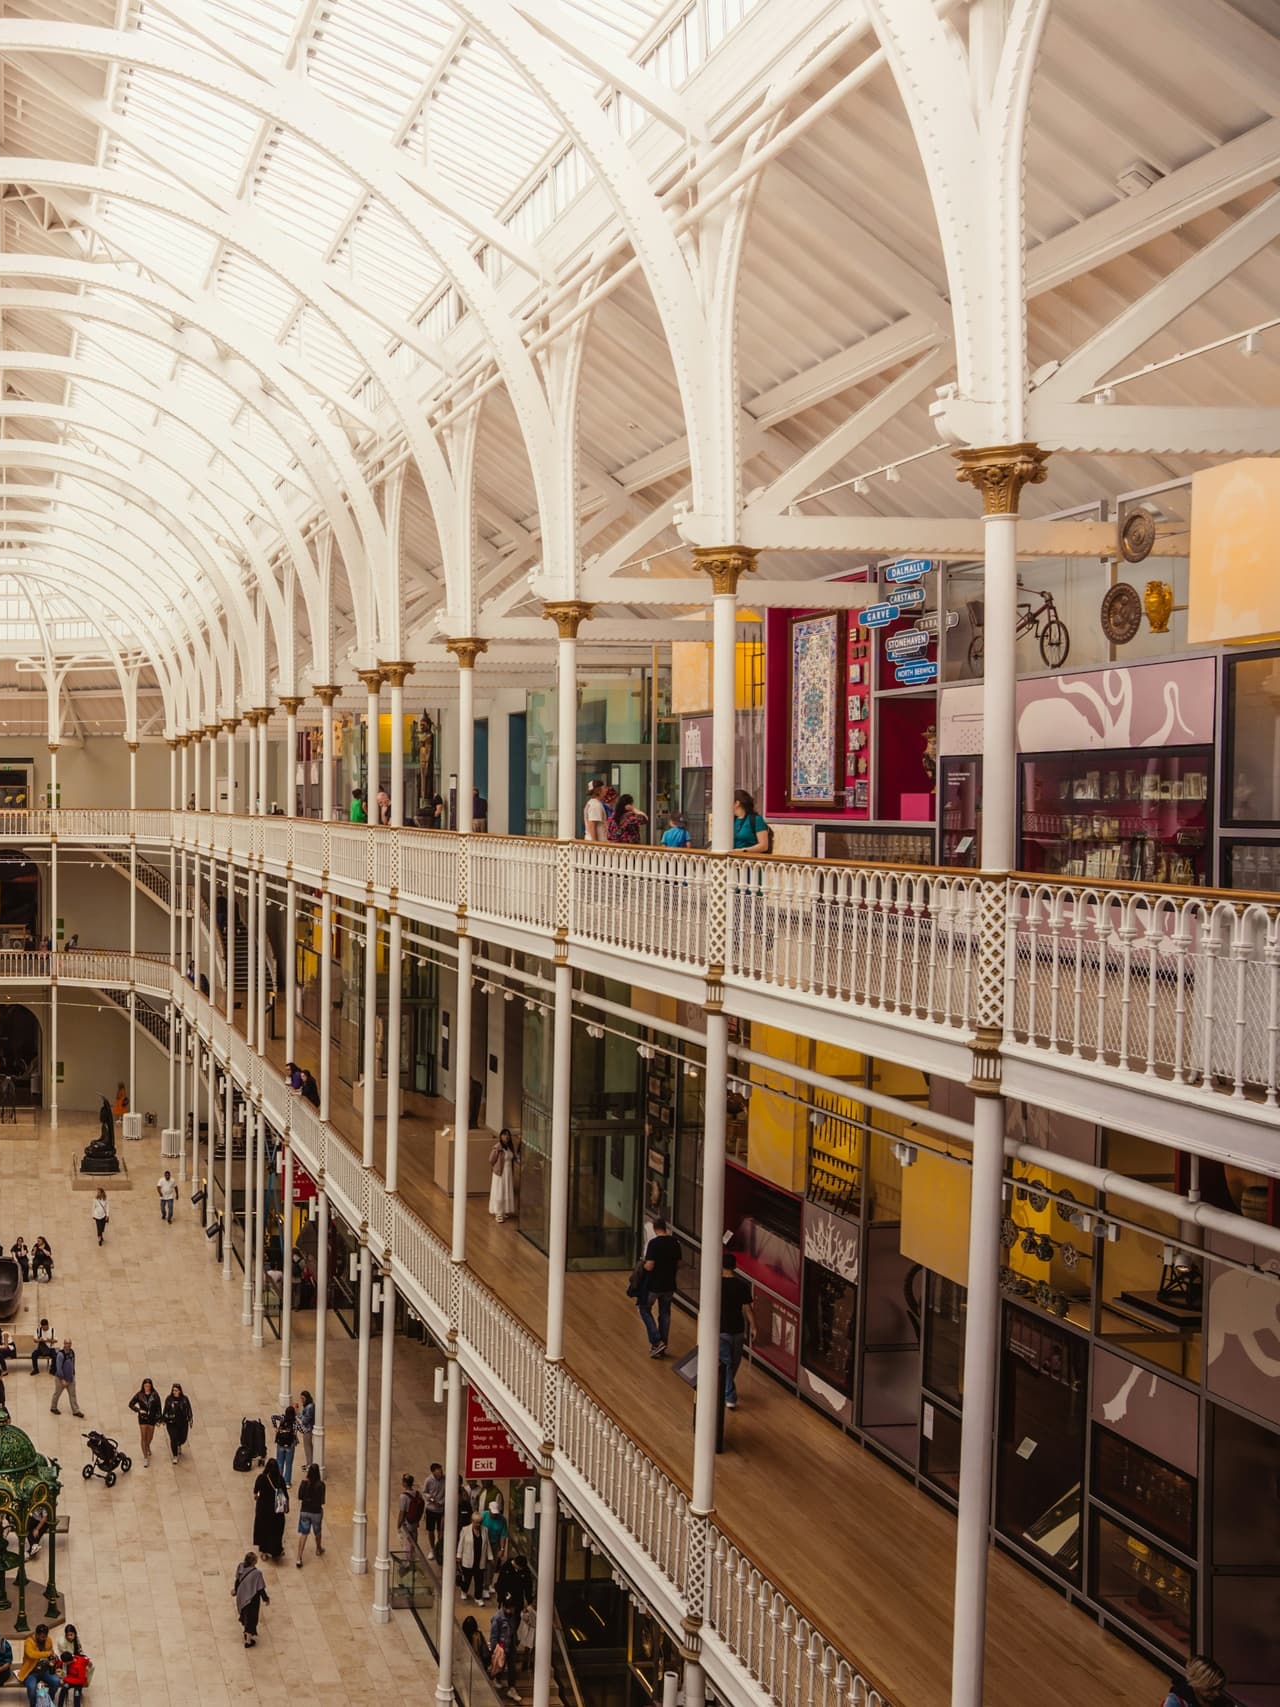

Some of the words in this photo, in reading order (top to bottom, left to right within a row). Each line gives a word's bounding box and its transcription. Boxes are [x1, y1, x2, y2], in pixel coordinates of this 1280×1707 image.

[891, 562, 925, 577] DALMALLY
[889, 591, 920, 603] CARSTAIRS
[867, 609, 890, 621] GARVE
[888, 634, 926, 649] STONEHAVEN
[898, 668, 914, 677] NORTH
[914, 666, 935, 675] BERWICK
[474, 1461, 494, 1469] Exit
